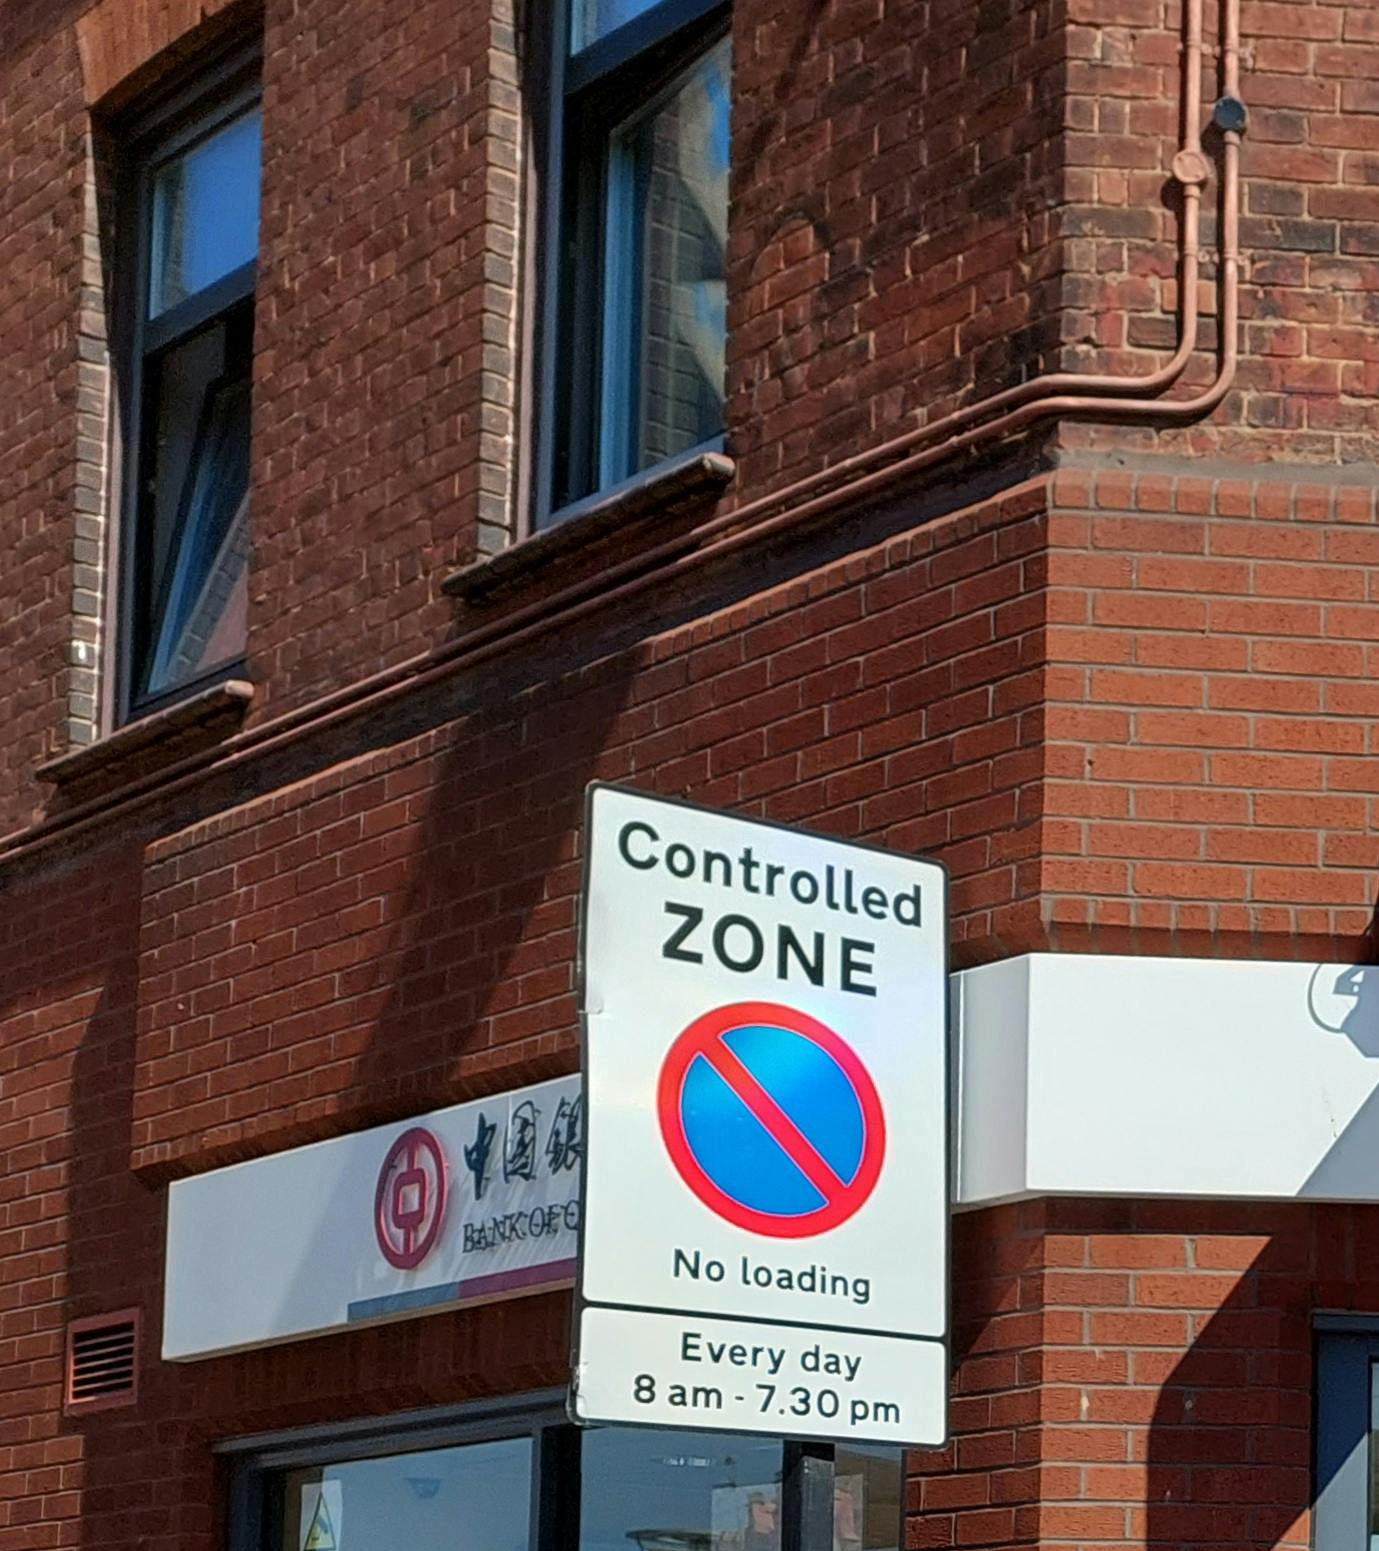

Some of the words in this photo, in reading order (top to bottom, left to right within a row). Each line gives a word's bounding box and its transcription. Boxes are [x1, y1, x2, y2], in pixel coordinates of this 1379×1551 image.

[618, 821, 922, 927] Controlled
[662, 902, 877, 997] ZONE
[463, 1211, 527, 1253] BANK
[529, 1206, 559, 1237] OF
[673, 1248, 725, 1283] No
[742, 1256, 871, 1303] loading
[681, 1332, 785, 1376] Every
[800, 1344, 862, 1382] day
[633, 1375, 656, 1404] 8
[668, 1382, 723, 1410] am
[755, 1384, 840, 1418] 7.30
[850, 1398, 901, 1426] pm
